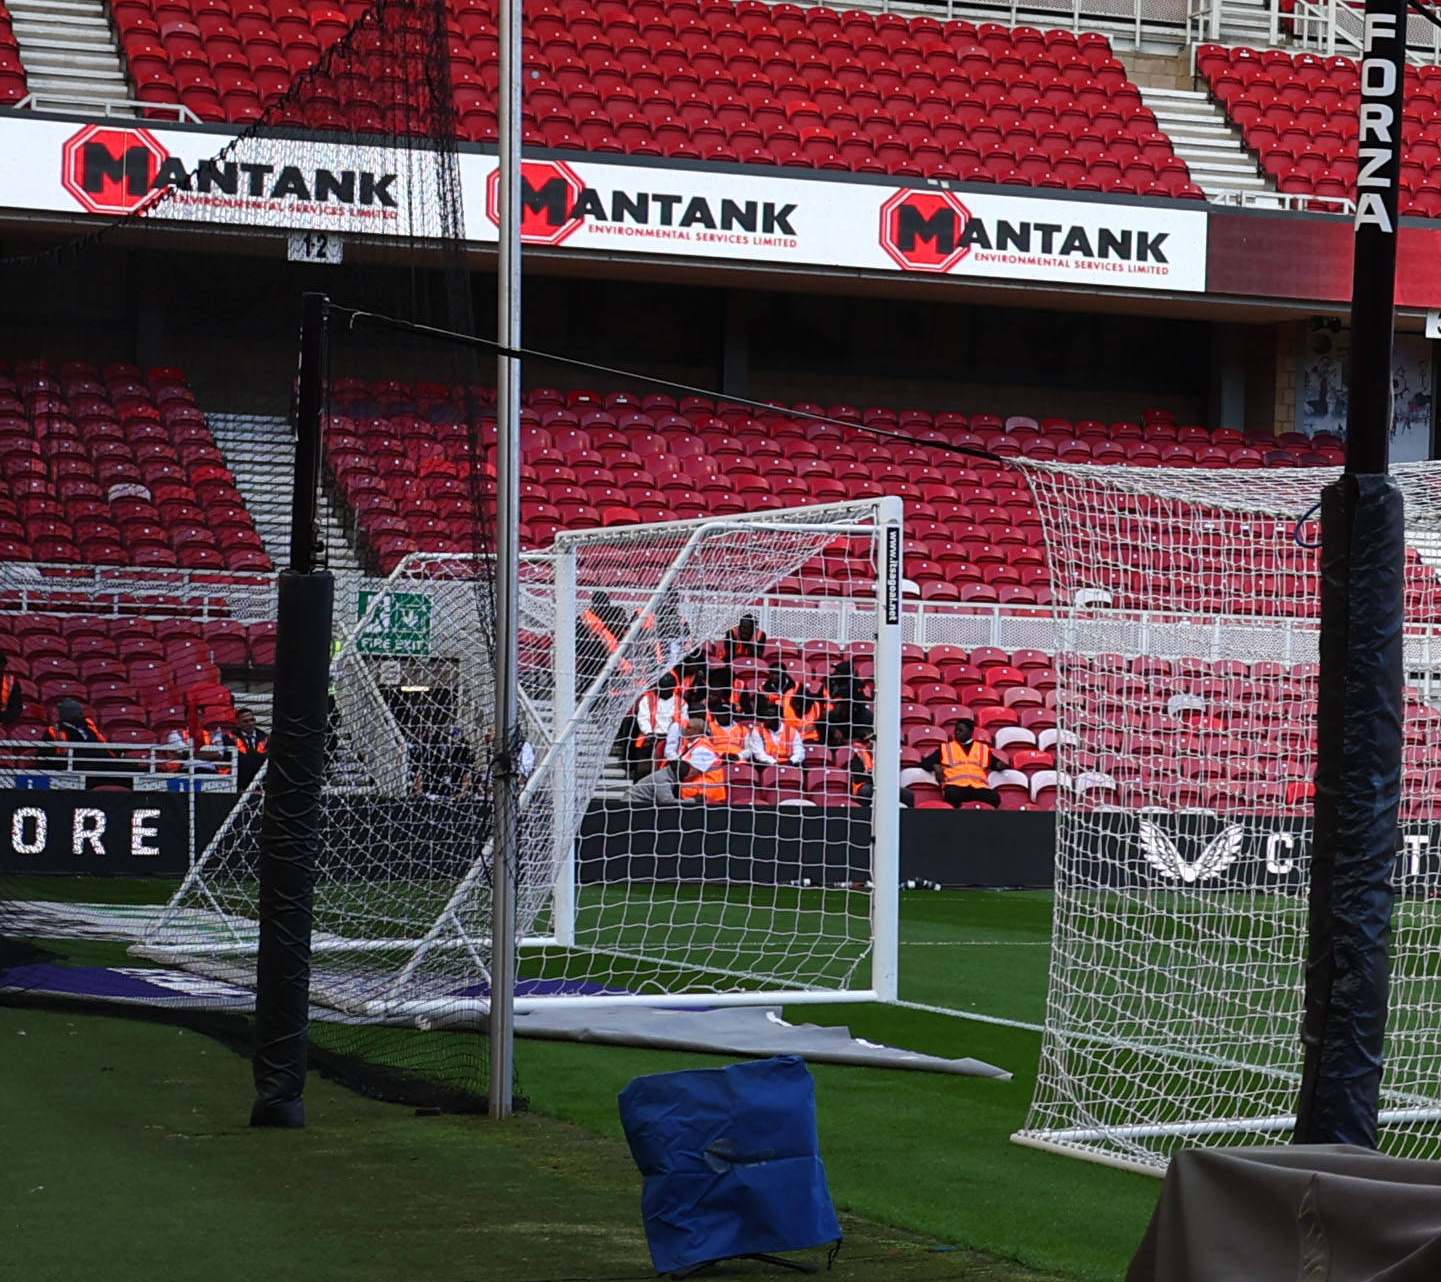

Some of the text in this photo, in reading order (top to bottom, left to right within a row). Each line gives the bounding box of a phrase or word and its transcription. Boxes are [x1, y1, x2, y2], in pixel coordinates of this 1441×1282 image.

[1354, 13, 1397, 234] FORZA
[84, 142, 399, 208] MANTANK
[520, 175, 799, 236] MANTANK
[898, 204, 1171, 264] MANTANK
[589, 224, 797, 248] ENVIRONMENTAL SERVICES LIMITED
[974, 252, 1170, 276] ENVIRONMENTAL SERVICES LIMITED
[888, 530, 898, 622] www.itsagoal.net
[361, 638, 392, 650] FIRE
